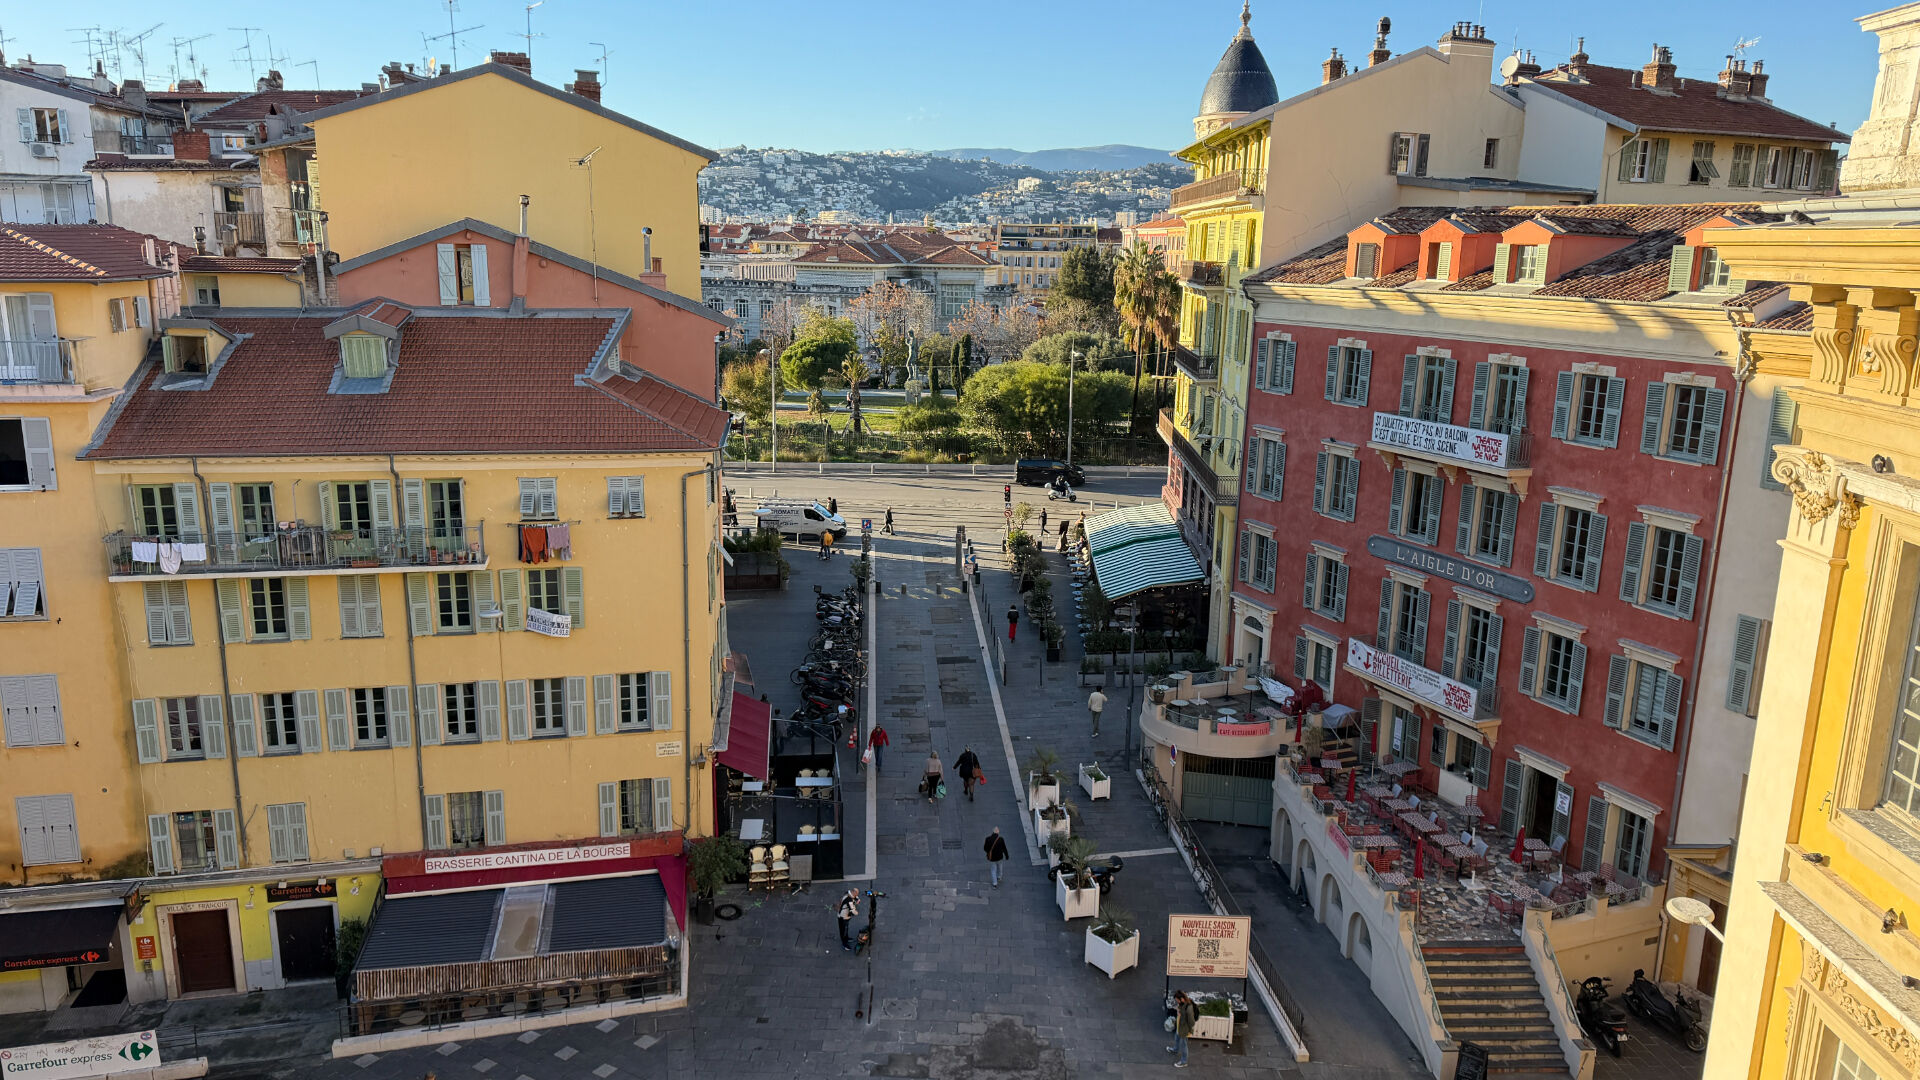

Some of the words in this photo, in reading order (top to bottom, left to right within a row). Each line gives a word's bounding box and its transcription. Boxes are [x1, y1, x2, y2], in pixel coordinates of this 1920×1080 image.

[1422, 423, 1433, 437] PAS
[1472, 442, 1502, 456] NATIONAL
[1474, 451, 1483, 459] DE
[1484, 453, 1499, 462] NICE
[1396, 547, 1454, 576] L'AIGLE
[1461, 566, 1494, 589] D'OR
[1373, 650, 1400, 672] ACCUEIL
[1372, 661, 1412, 690] BILLETTERIE
[426, 856, 493, 871] BRASSERIE
[495, 853, 545, 866] CANTINA
[549, 851, 564, 861] DE
[567, 849, 581, 860] LA
[583, 846, 630, 858] BOURSE
[270, 886, 313, 896] Carrefour
[1182, 920, 1212, 929] NOUVELLE
[1213, 920, 1236, 930] SAISON,
[1180, 928, 1198, 937] VENEZ
[1200, 930, 1208, 938] AU
[4, 958, 45, 968] Carrefour
[46, 956, 78, 964] express
[7, 1057, 68, 1073] Carrefour
[70, 1052, 113, 1065] express
